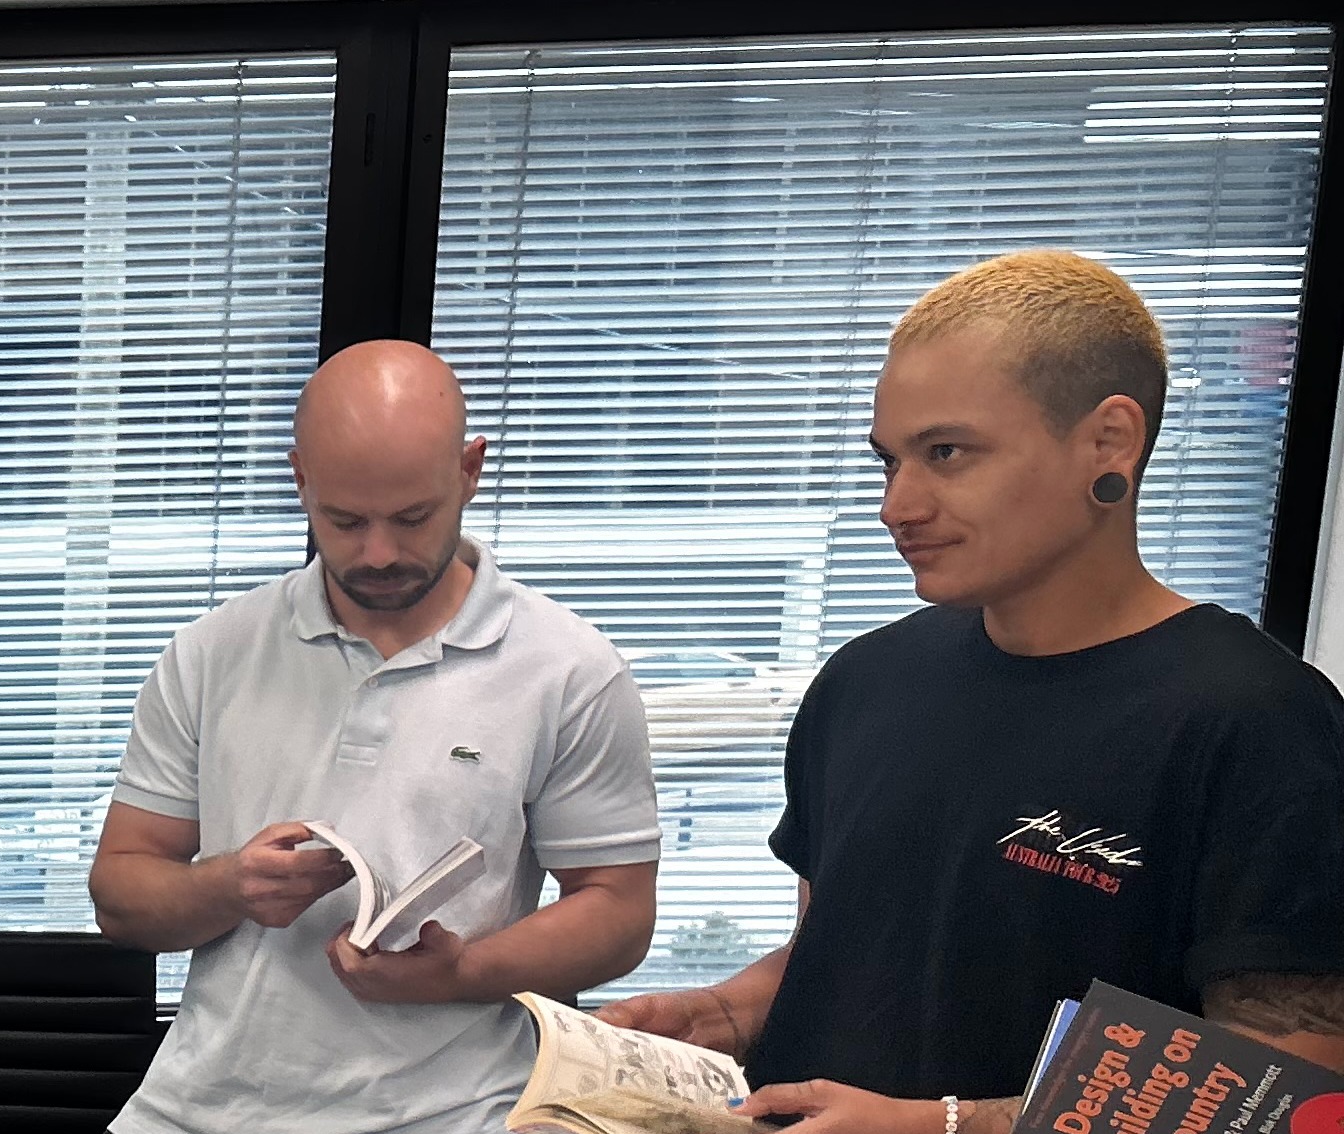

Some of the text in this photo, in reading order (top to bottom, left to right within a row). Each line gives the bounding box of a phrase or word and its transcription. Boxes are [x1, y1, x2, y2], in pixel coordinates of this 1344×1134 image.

[996, 809, 1144, 866] The Used
[1104, 1022, 1146, 1048] &
[1163, 1028, 1202, 1063] on
[1229, 1106, 1253, 1132] Paul
